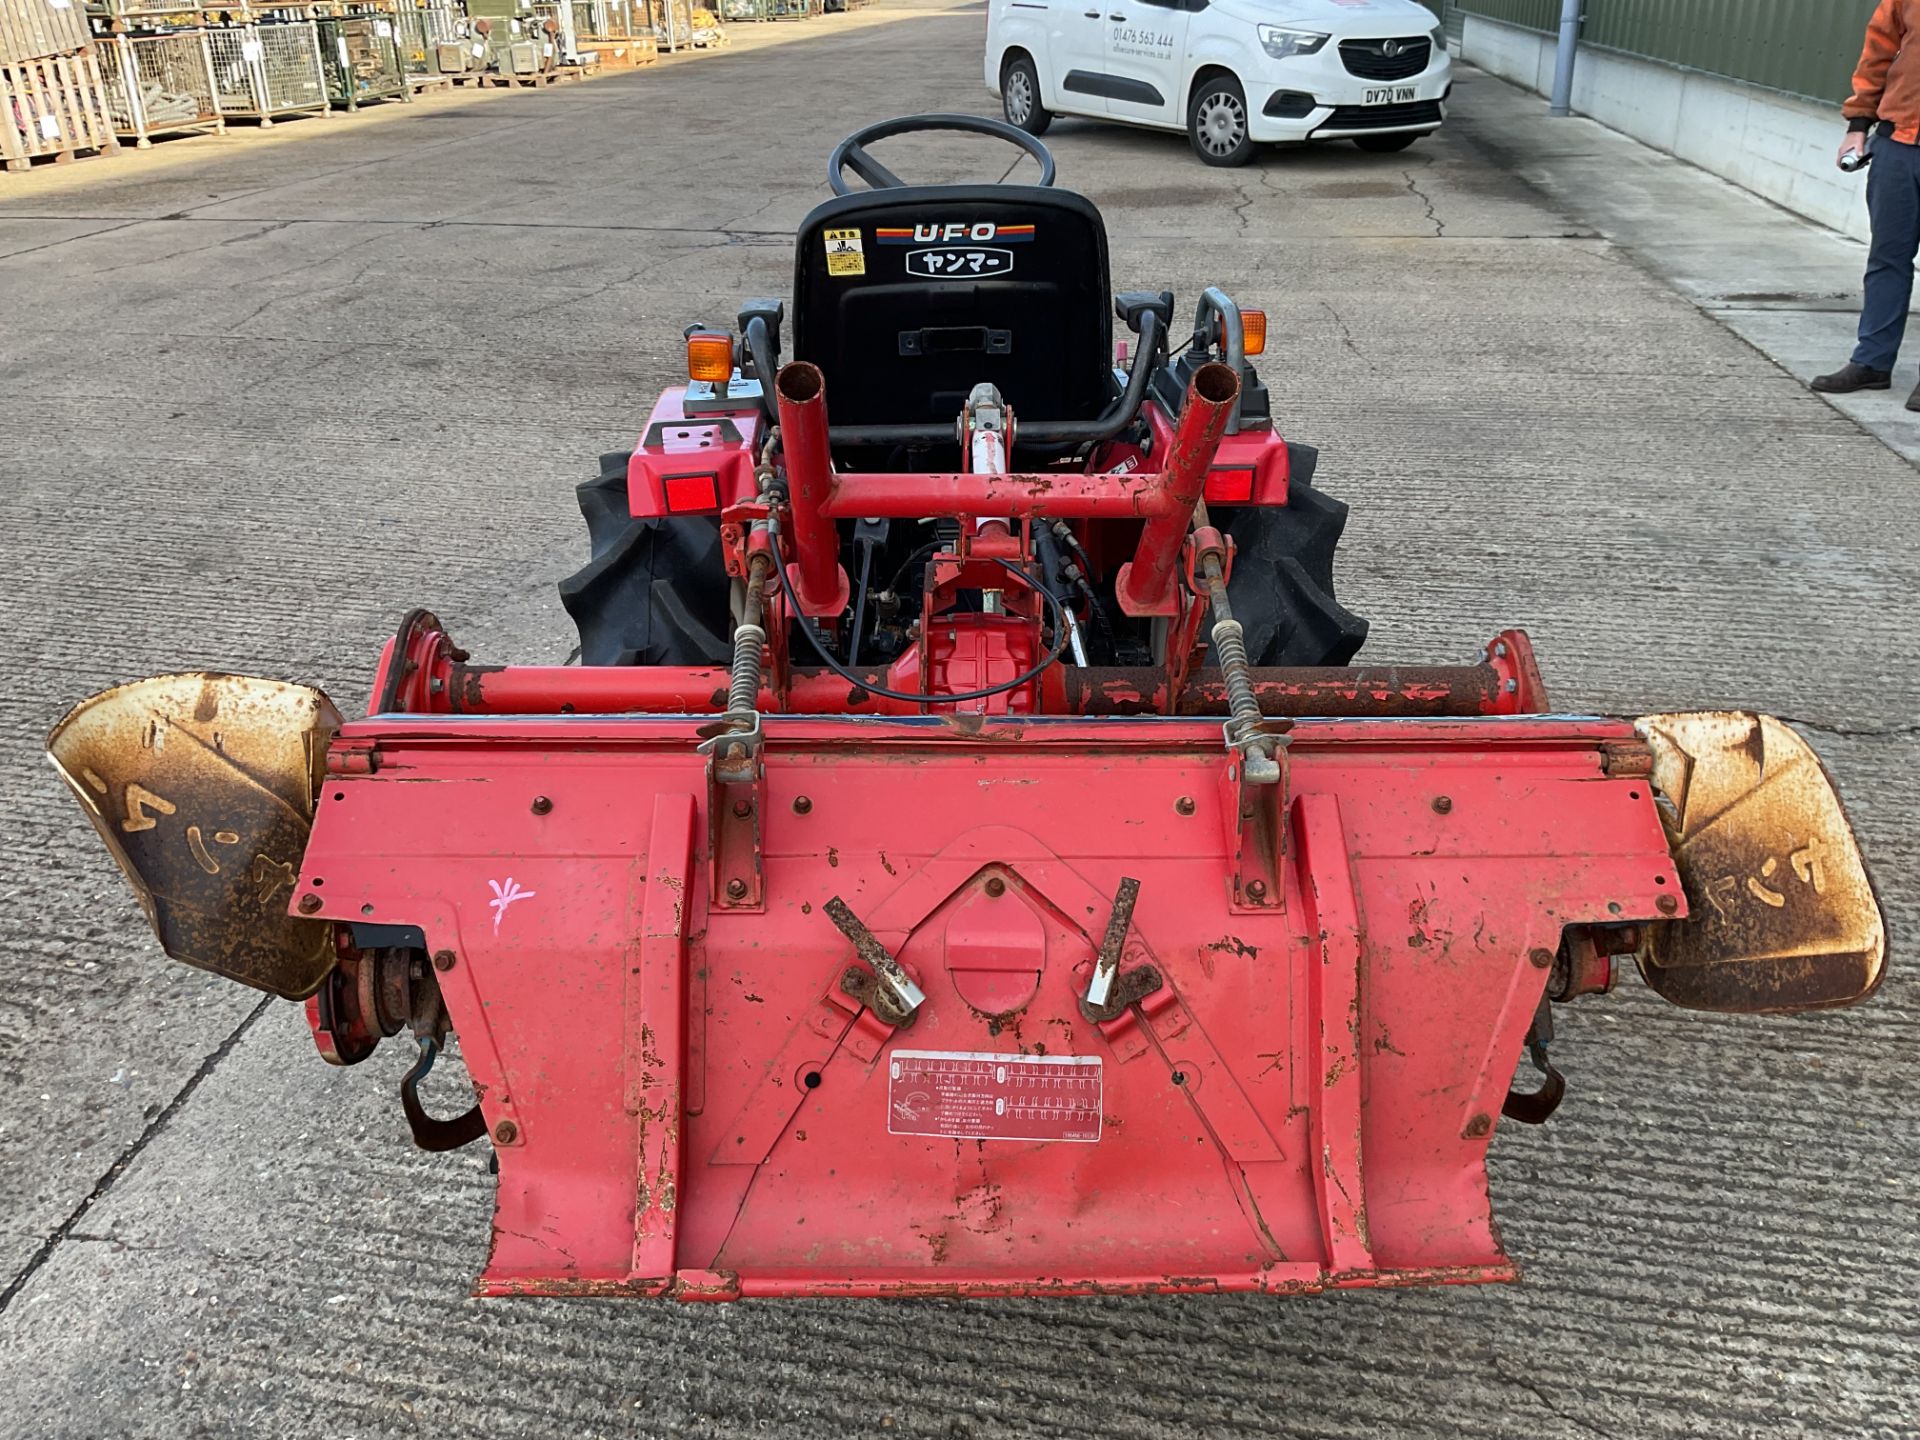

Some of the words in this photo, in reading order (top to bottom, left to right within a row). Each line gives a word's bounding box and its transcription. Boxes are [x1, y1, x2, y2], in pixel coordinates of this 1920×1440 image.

[1113, 27, 1137, 43] 01476
[1138, 30, 1155, 45] 563
[1156, 33, 1174, 47] 444
[1366, 89, 1393, 103] DV70
[1396, 87, 1416, 101] VNN
[913, 223, 996, 242] UFO
[922, 252, 1000, 273] ヤンマー
